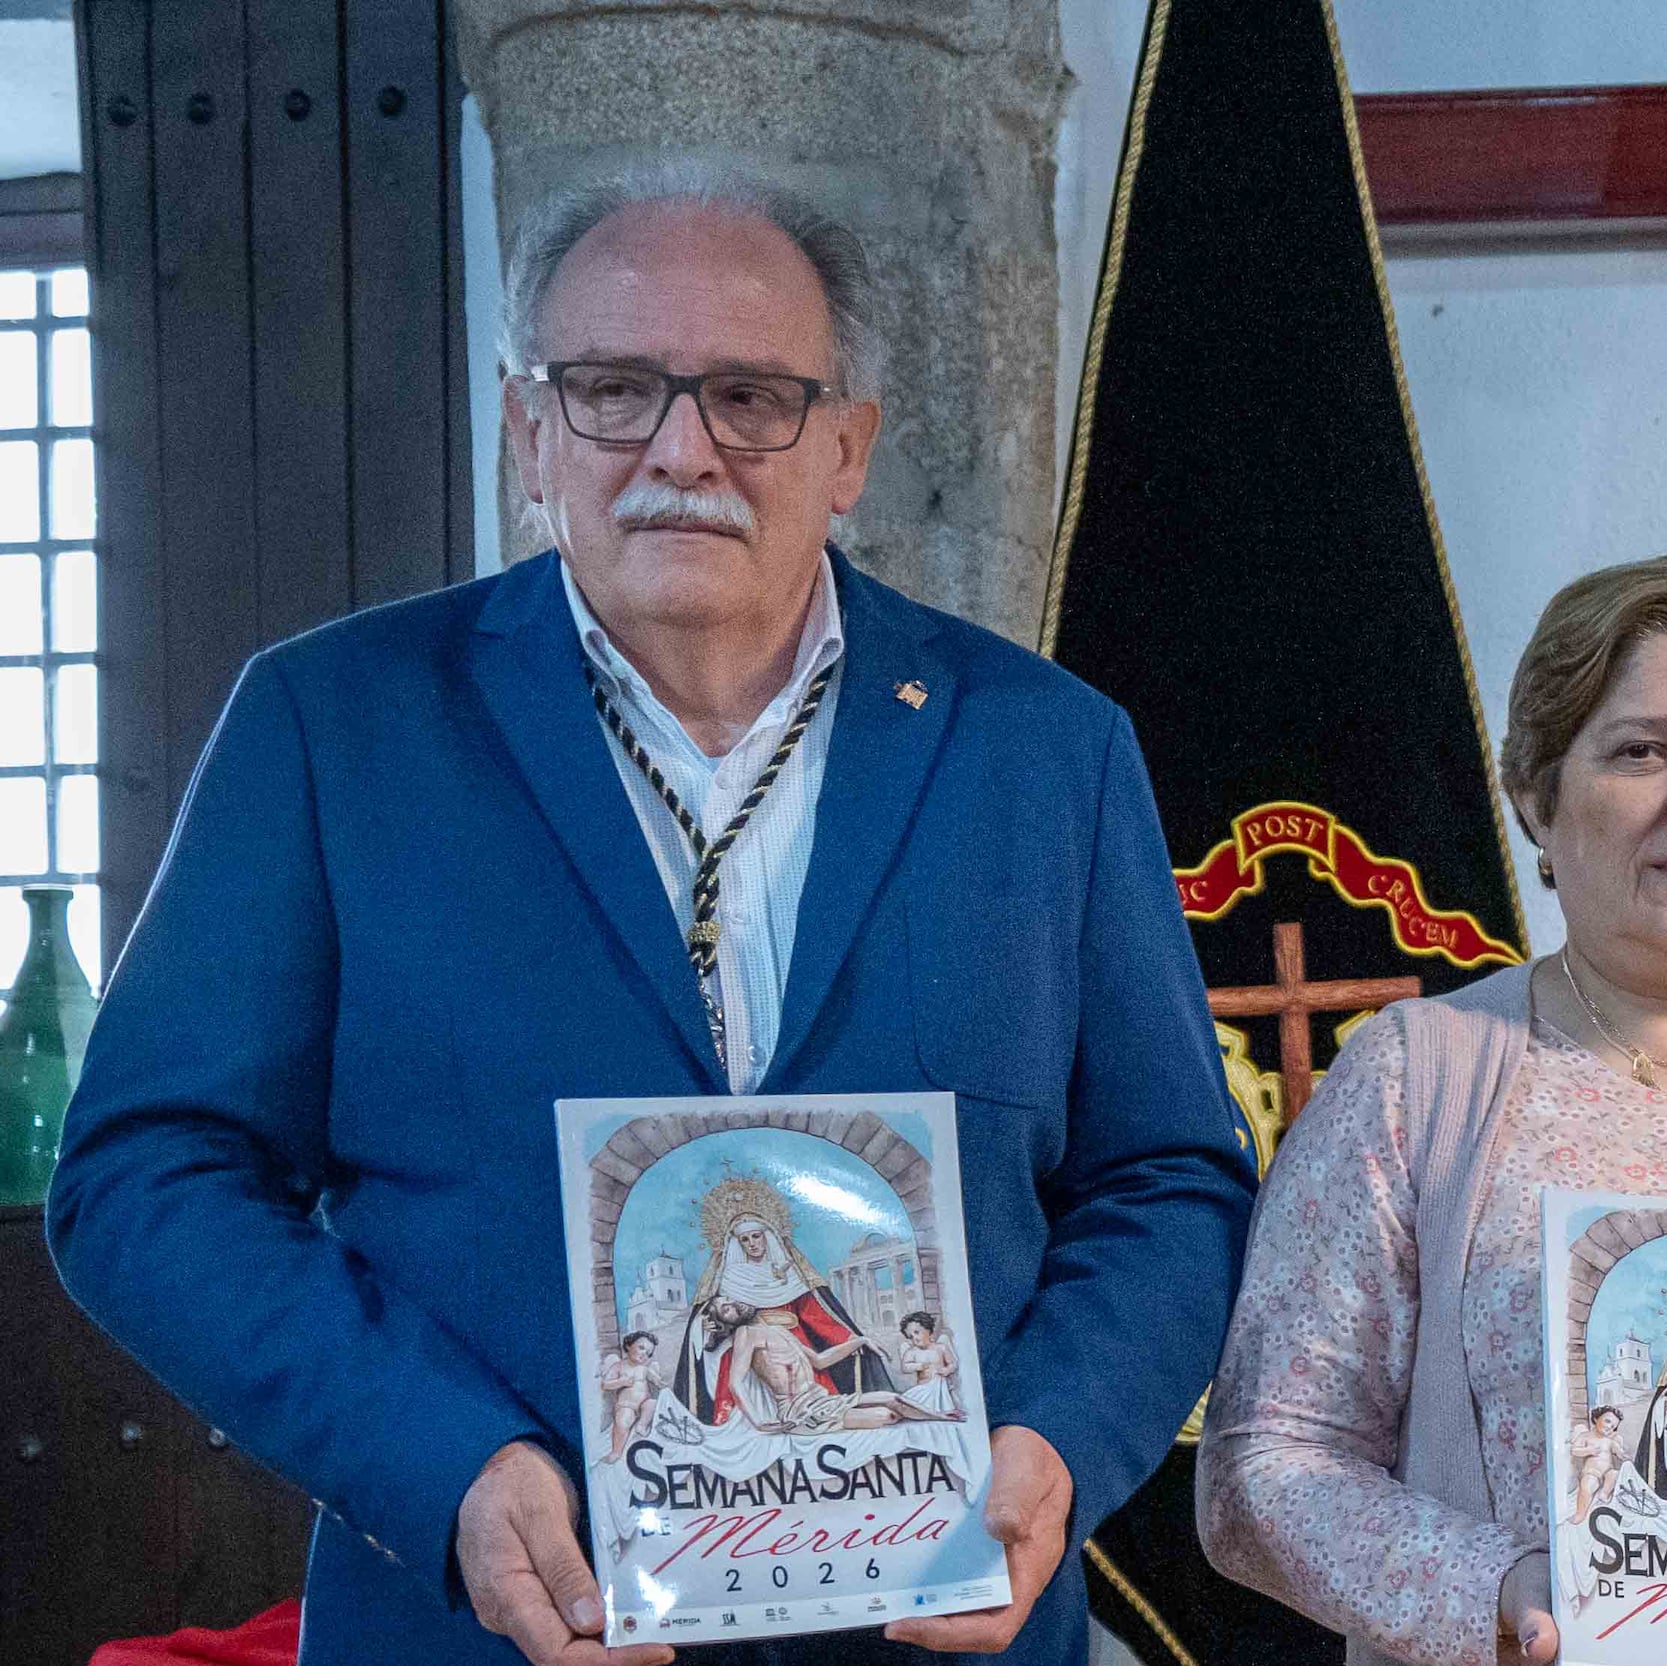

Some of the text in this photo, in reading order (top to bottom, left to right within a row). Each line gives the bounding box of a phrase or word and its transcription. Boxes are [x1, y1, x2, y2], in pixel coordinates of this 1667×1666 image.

[1246, 815, 1324, 846] POST
[1367, 874, 1459, 950] CRUCEM
[817, 1444, 956, 1500] SANTA
[650, 1497, 950, 1576] Mérida
[1599, 1581, 1625, 1599] DE
